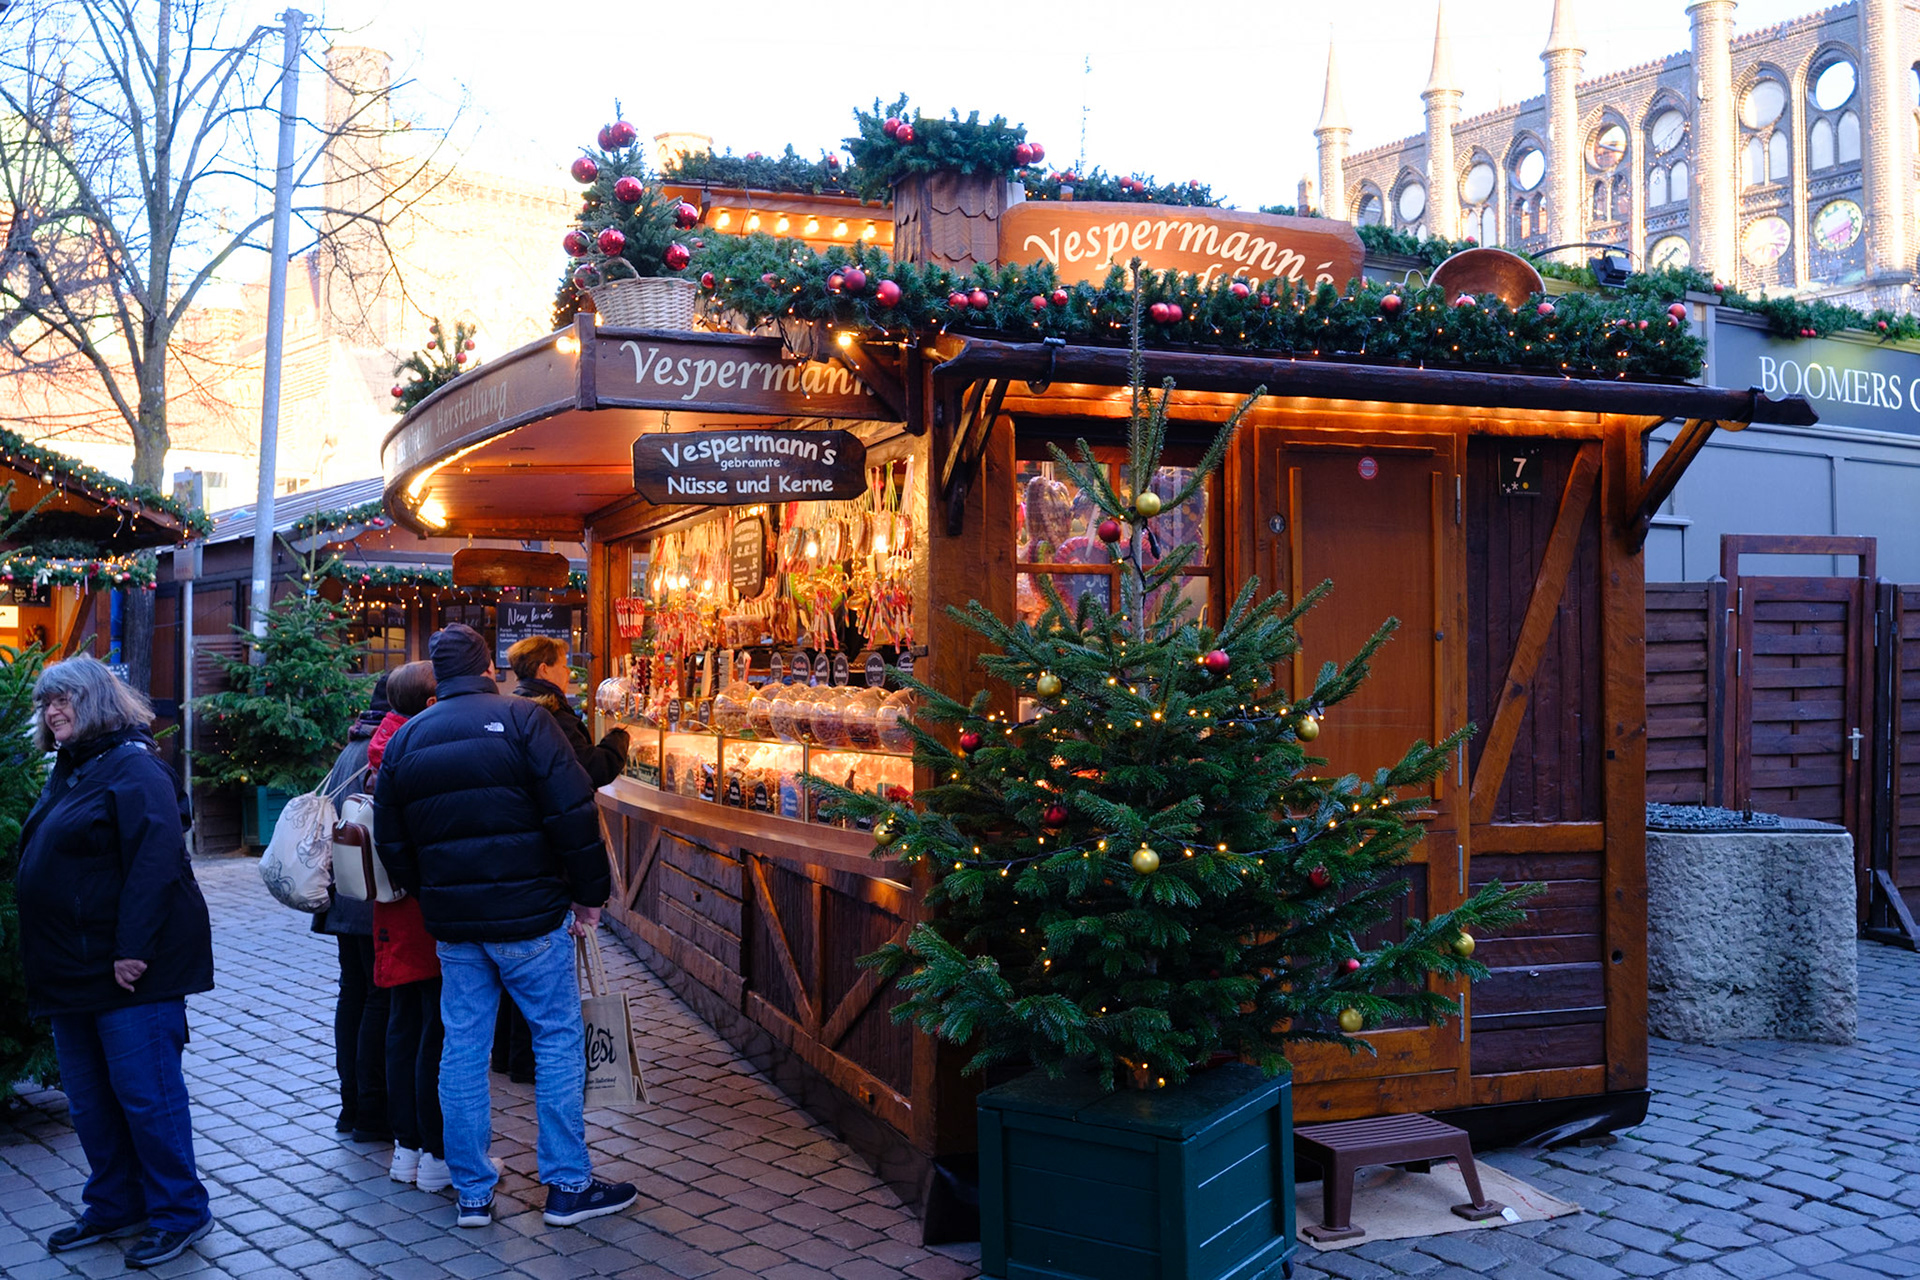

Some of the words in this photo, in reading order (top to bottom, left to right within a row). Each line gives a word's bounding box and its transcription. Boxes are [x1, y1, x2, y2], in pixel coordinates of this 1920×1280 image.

[1759, 356, 1903, 410] BOOMERS
[435, 380, 508, 438] Herstellung
[720, 457, 781, 472] gebrannte
[1513, 457, 1527, 478] 7
[667, 476, 728, 495] Nüsse
[736, 475, 770, 494] und
[778, 475, 834, 493] Kerne
